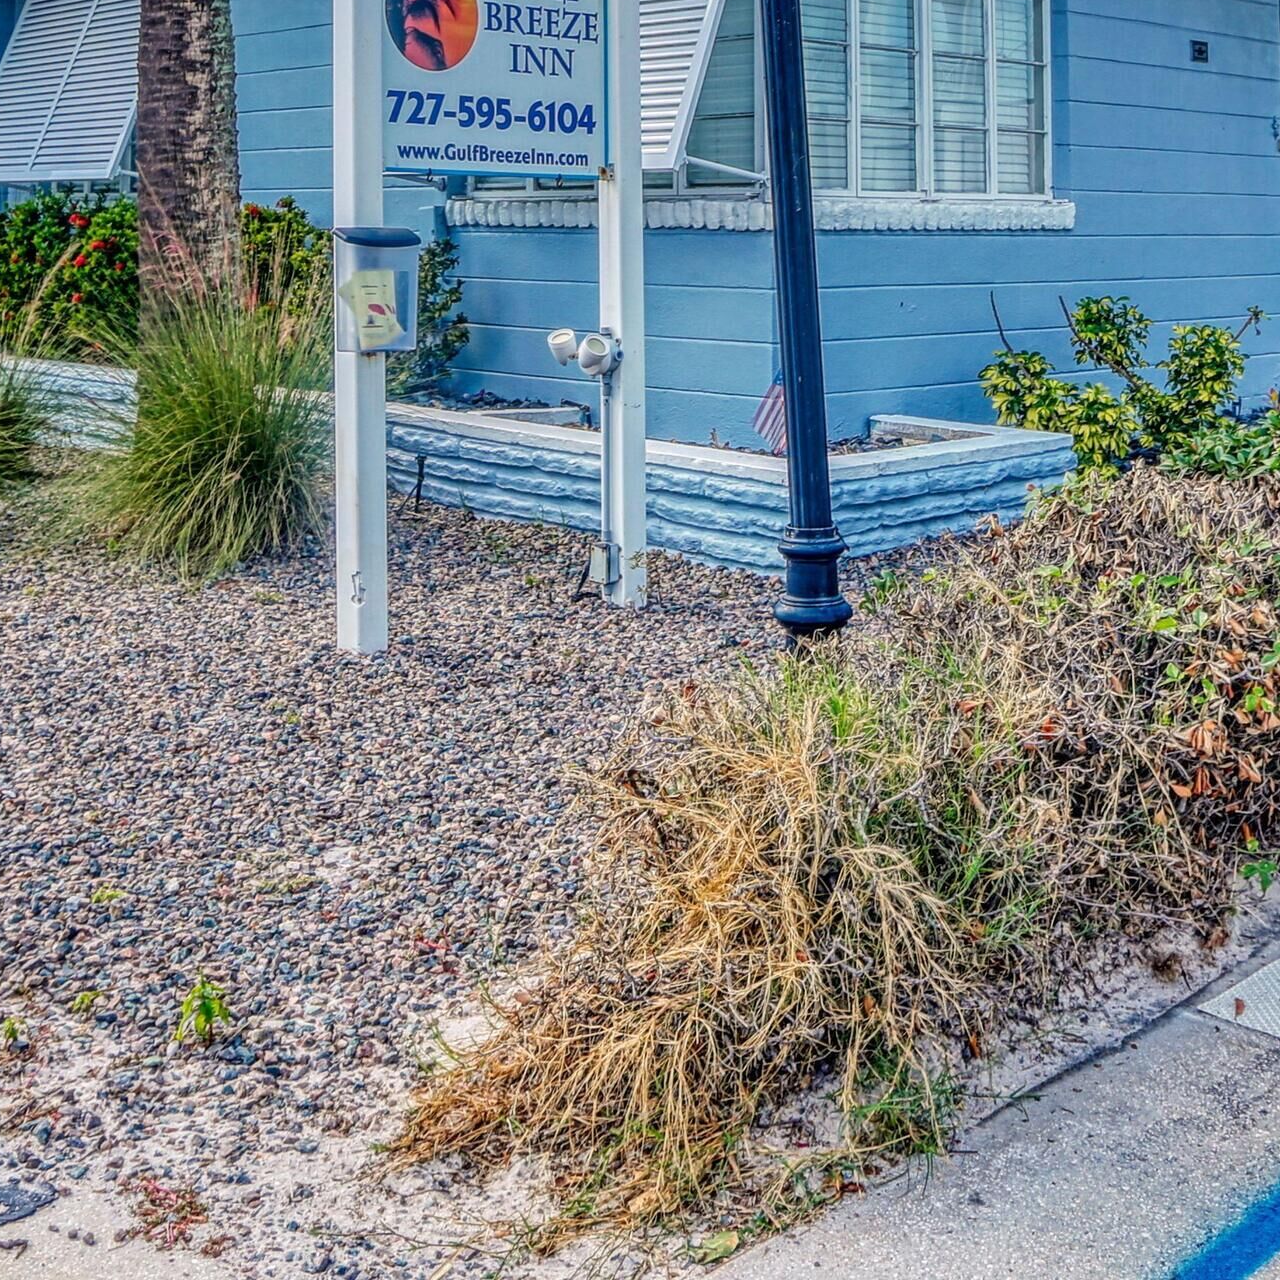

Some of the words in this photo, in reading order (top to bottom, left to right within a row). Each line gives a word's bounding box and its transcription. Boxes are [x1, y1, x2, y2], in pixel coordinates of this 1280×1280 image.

[483, 1, 599, 44] BREEZE
[509, 43, 575, 79] INN
[386, 90, 596, 134] 727-595-6104
[397, 143, 588, 167] www.GulfBreezeInn.com
